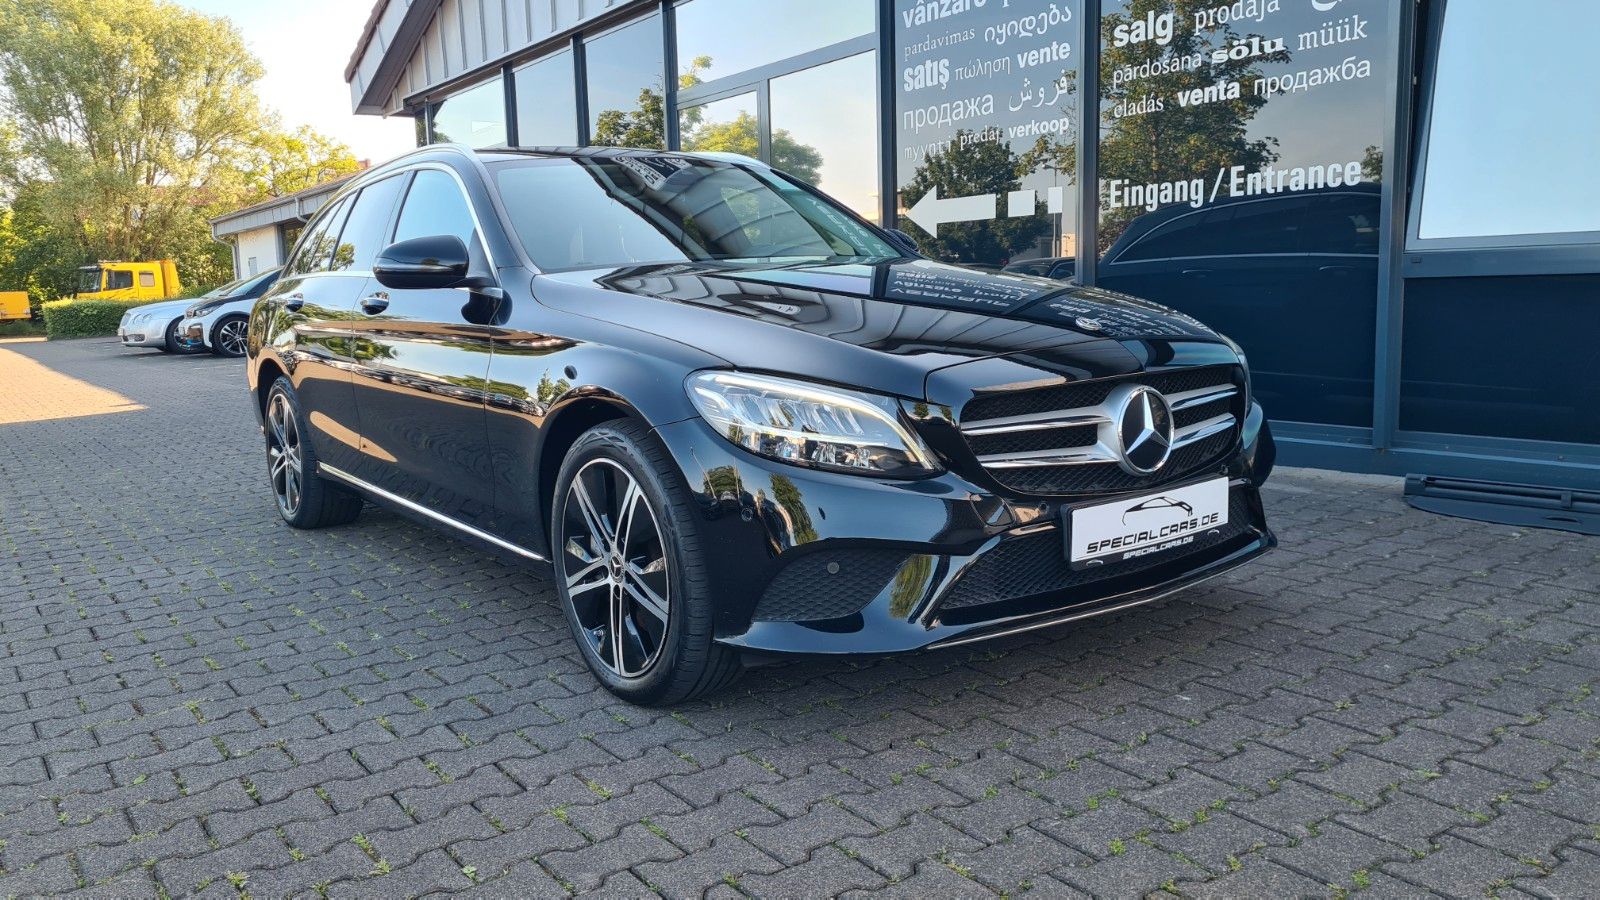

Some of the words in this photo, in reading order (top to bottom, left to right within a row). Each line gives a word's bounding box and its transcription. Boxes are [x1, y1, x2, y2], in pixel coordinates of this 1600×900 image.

[904, 28, 976, 61] pardavimas
[1113, 10, 1174, 47] salg
[1017, 42, 1071, 69] vente
[1113, 53, 1202, 89] pārdošana
[1211, 37, 1286, 64] sölu
[1298, 14, 1368, 51] müük
[903, 58, 950, 92] satış
[1177, 81, 1240, 107] venta
[1253, 56, 1371, 98] продажба
[904, 93, 994, 135] продажа
[904, 136, 951, 162] myynti
[960, 124, 1000, 151] predaj
[1008, 117, 1070, 139] verkoop
[1110, 178, 1204, 212] Eingang
[1229, 161, 1362, 197] Entrance
[1086, 511, 1220, 555] SPECIALCARS.DE
